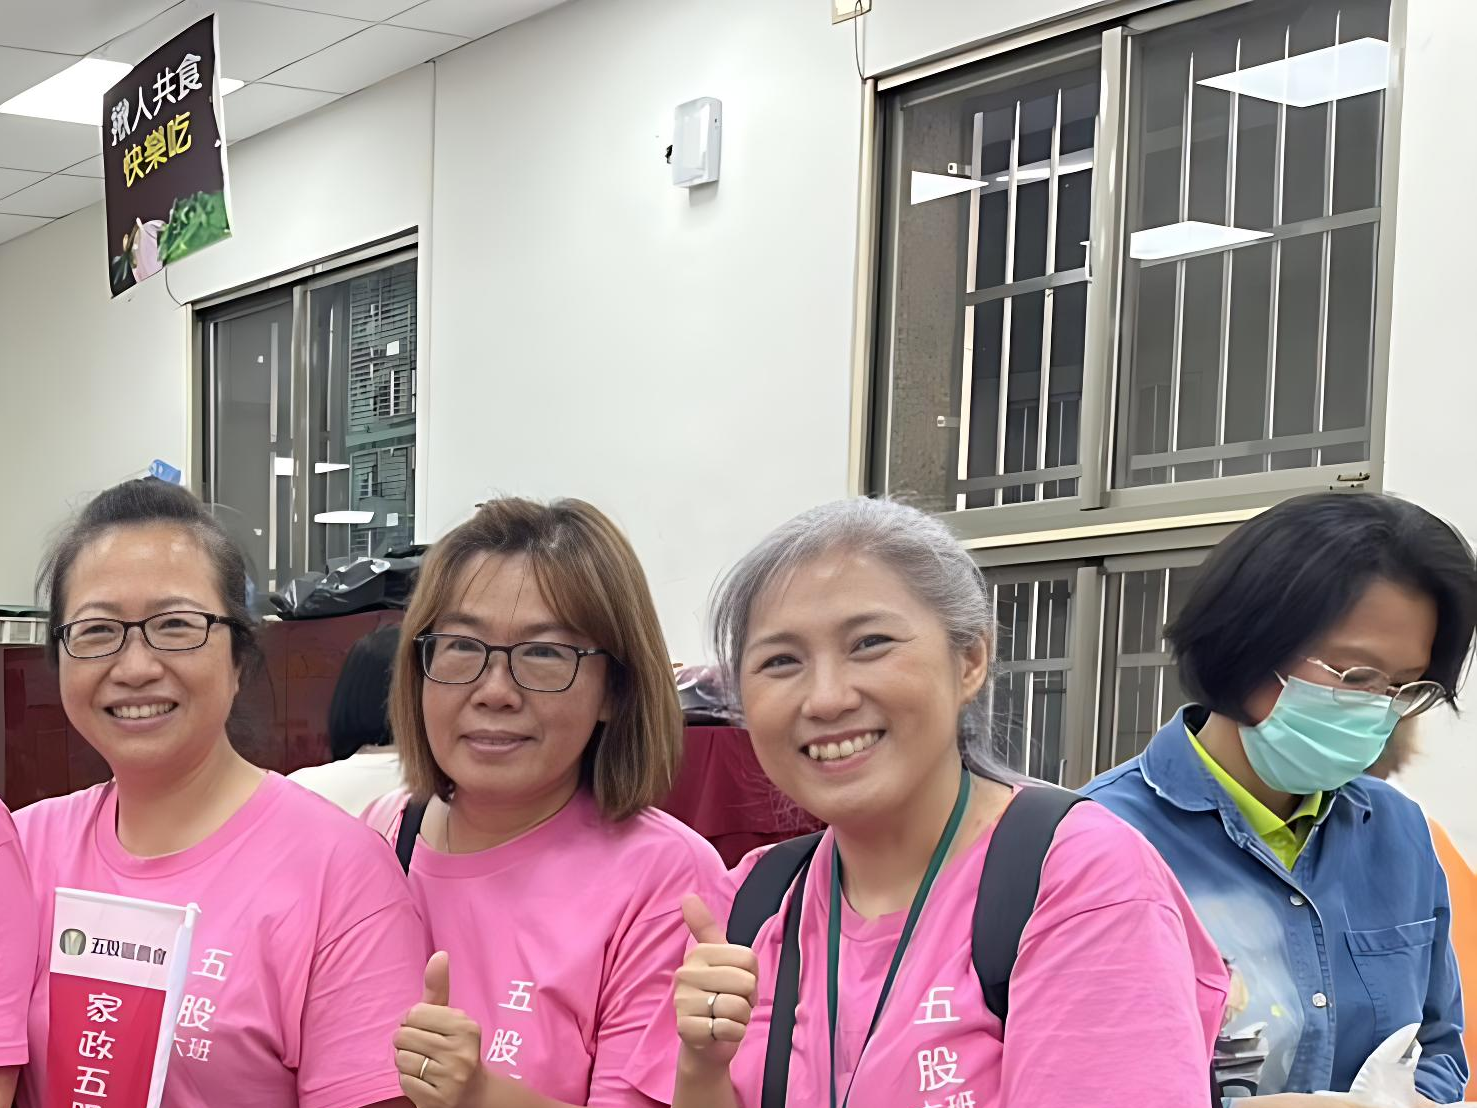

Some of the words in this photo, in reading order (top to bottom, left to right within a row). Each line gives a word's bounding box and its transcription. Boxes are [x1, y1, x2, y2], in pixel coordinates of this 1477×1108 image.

[123, 111, 192, 188] 快樂吃
[486, 979, 535, 1067] 五股
[912, 986, 965, 1092] 五股
